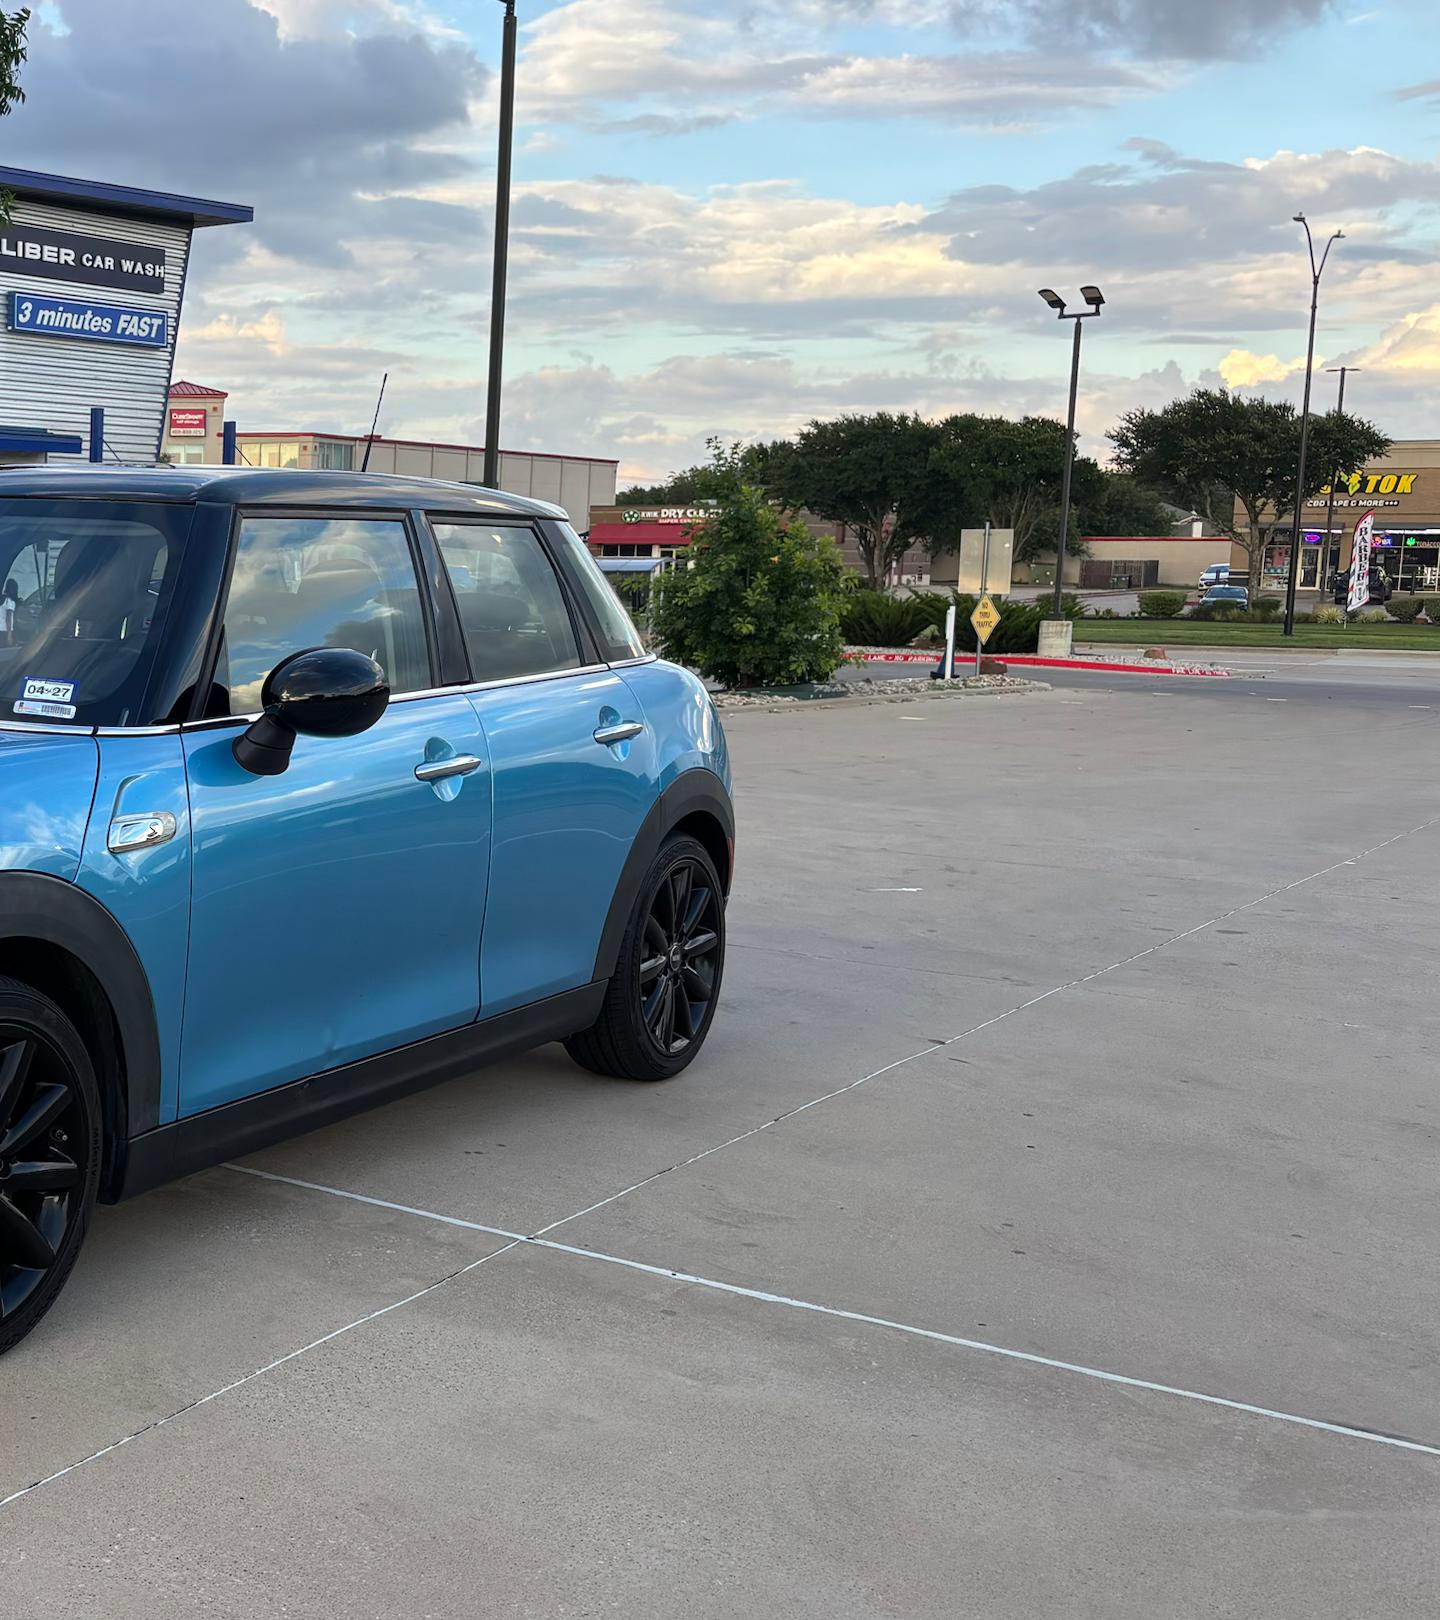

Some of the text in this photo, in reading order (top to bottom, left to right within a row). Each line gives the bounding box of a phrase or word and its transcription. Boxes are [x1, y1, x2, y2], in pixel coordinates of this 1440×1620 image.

[81, 254, 114, 270] CAR
[120, 259, 165, 278] WASH
[17, 302, 162, 338] 3 minutes FAST
[1365, 474, 1417, 494] TOK
[661, 509, 685, 518] DRY
[27, 684, 45, 694] 04
[51, 687, 71, 697] 27
